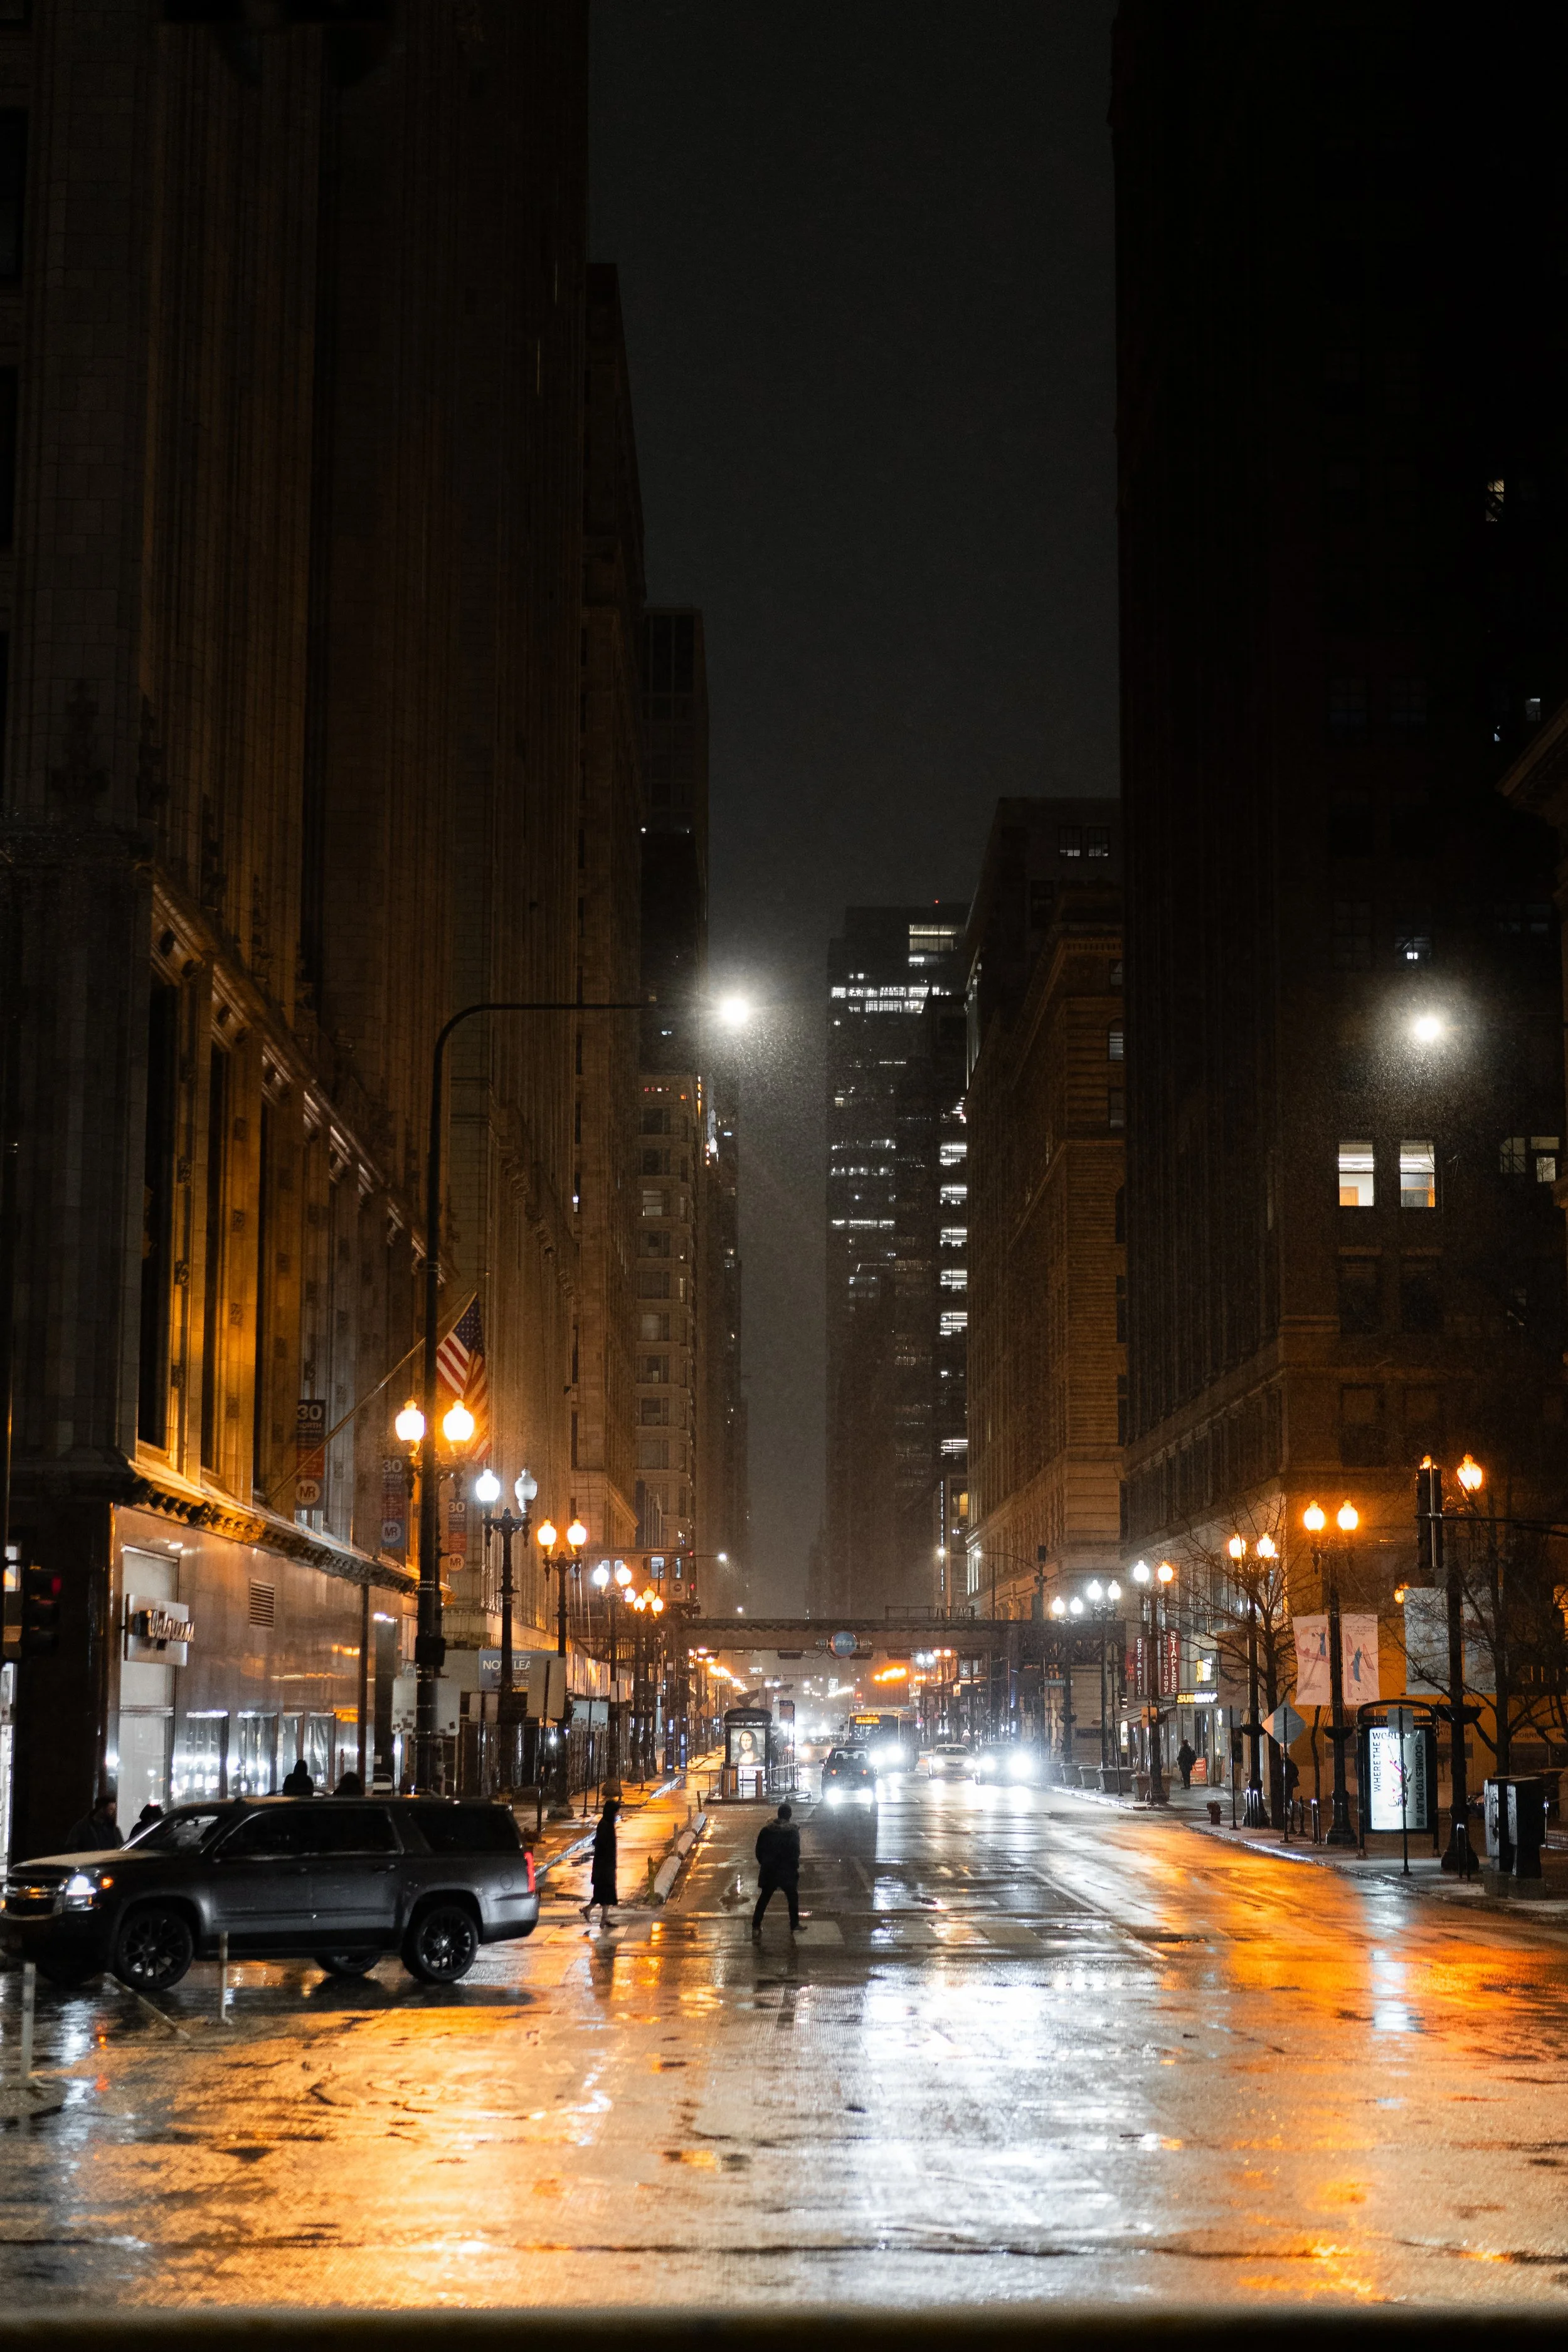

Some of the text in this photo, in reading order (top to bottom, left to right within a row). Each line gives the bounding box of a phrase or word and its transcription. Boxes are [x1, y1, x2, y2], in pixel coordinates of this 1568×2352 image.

[297, 1405, 322, 1421] 30
[383, 1459, 403, 1473] 30
[448, 1502, 465, 1513] 30
[483, 1660, 502, 1670] NO
[1177, 1693, 1218, 1703] SUBWAY
[1416, 1745, 1424, 1776] COMES
[1373, 1761, 1381, 1793] WHERE
[1416, 1779, 1424, 1791] TO
[1416, 1793, 1424, 1814] PLAY
